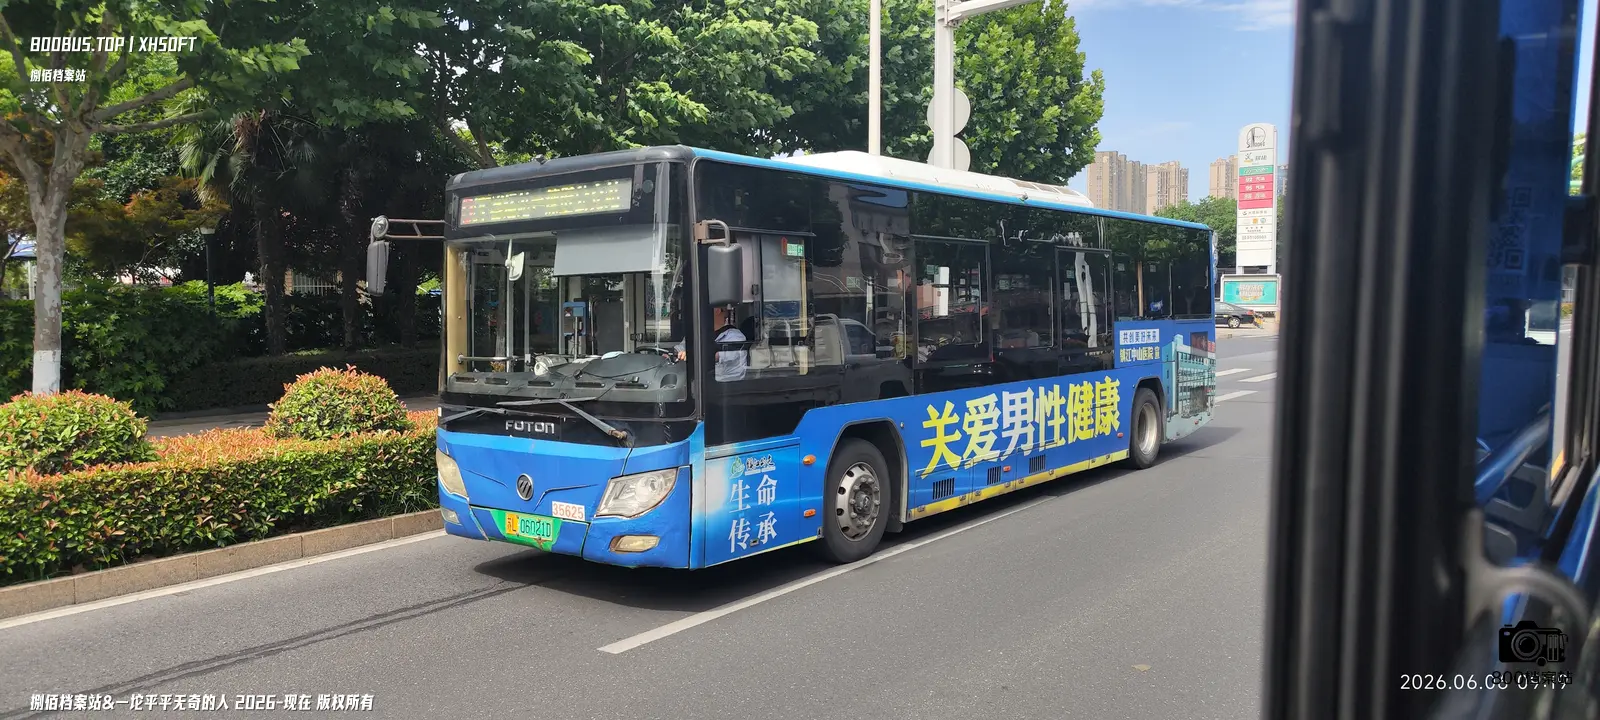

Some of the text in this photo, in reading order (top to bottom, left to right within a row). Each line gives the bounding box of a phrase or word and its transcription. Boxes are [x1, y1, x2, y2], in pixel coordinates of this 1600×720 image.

[505, 419, 555, 434] FOTON
[920, 376, 1120, 479] 关爱男性健康
[552, 503, 584, 519] 35625
[729, 474, 778, 513] 生命
[728, 511, 778, 553] 传承
